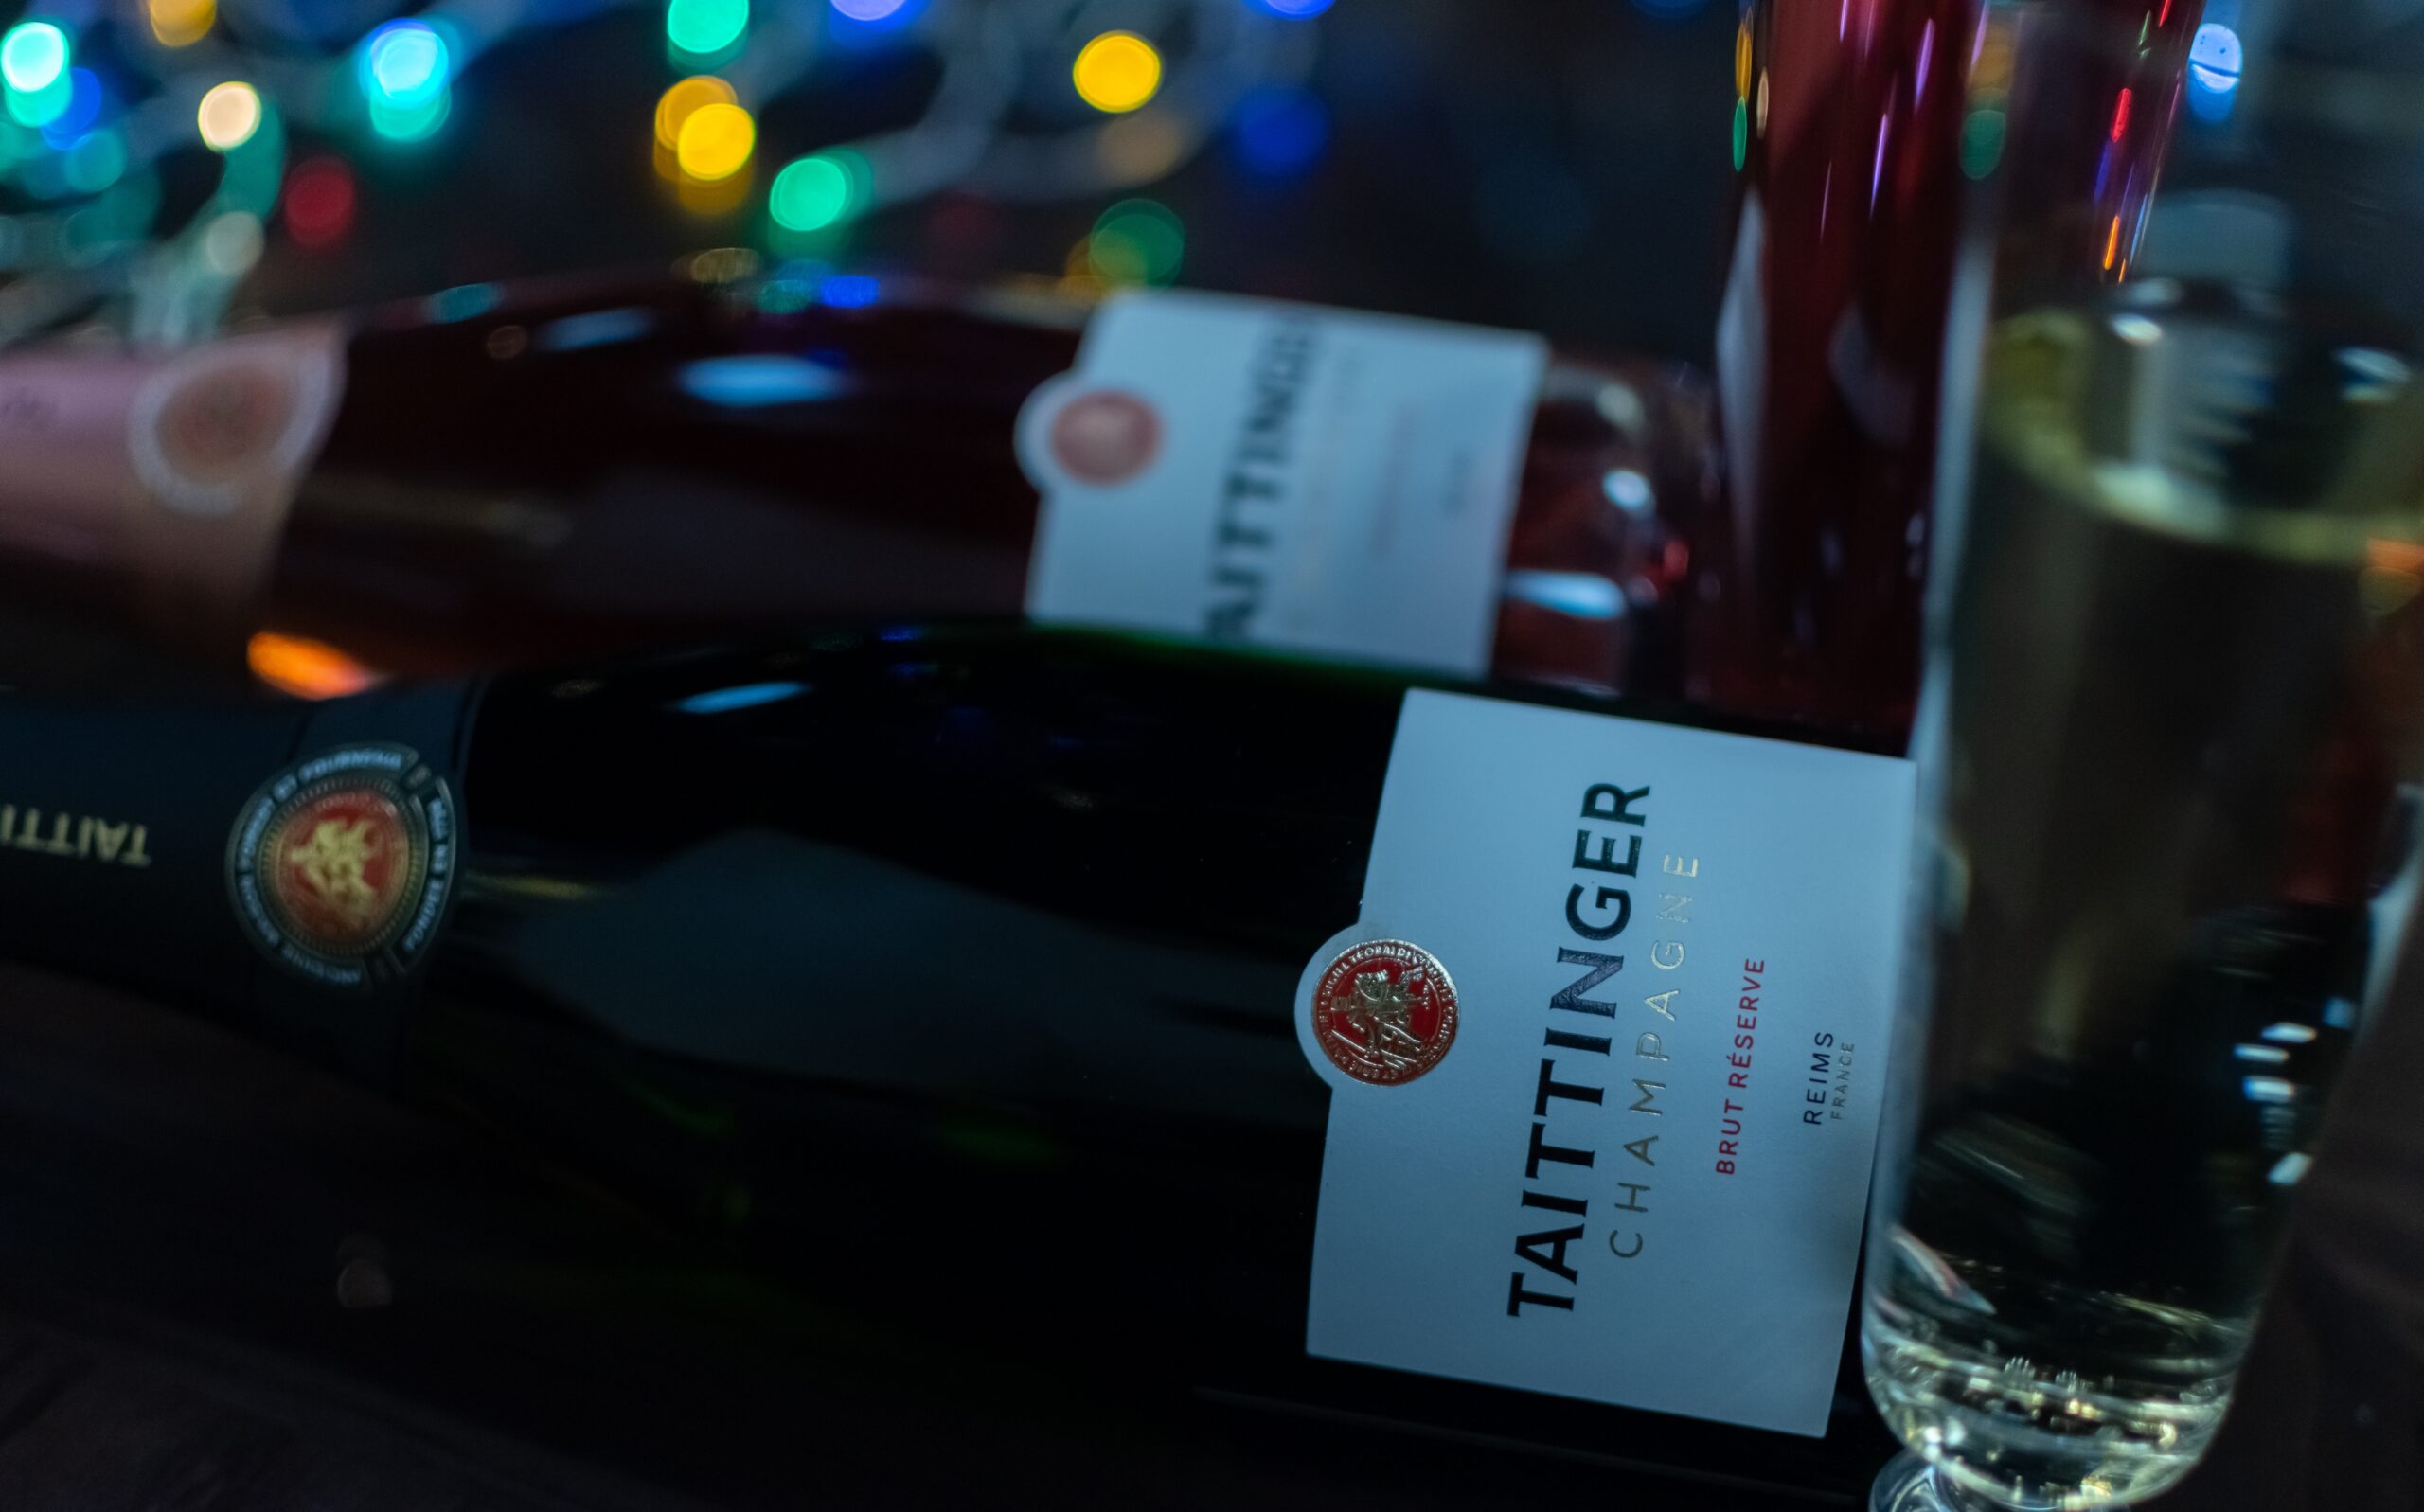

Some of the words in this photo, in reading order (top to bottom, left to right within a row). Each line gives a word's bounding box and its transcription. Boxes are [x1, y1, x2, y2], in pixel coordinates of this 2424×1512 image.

[1507, 782, 1652, 1319] TAITTINGER
[1608, 853, 1701, 1260] CHAMPAGNE
[1726, 957, 1766, 1089] RÉSERVE
[1803, 1030, 1834, 1127] REIMS
[1715, 1099, 1744, 1176] BRUT
[1830, 1042, 1855, 1122] FRANCE
